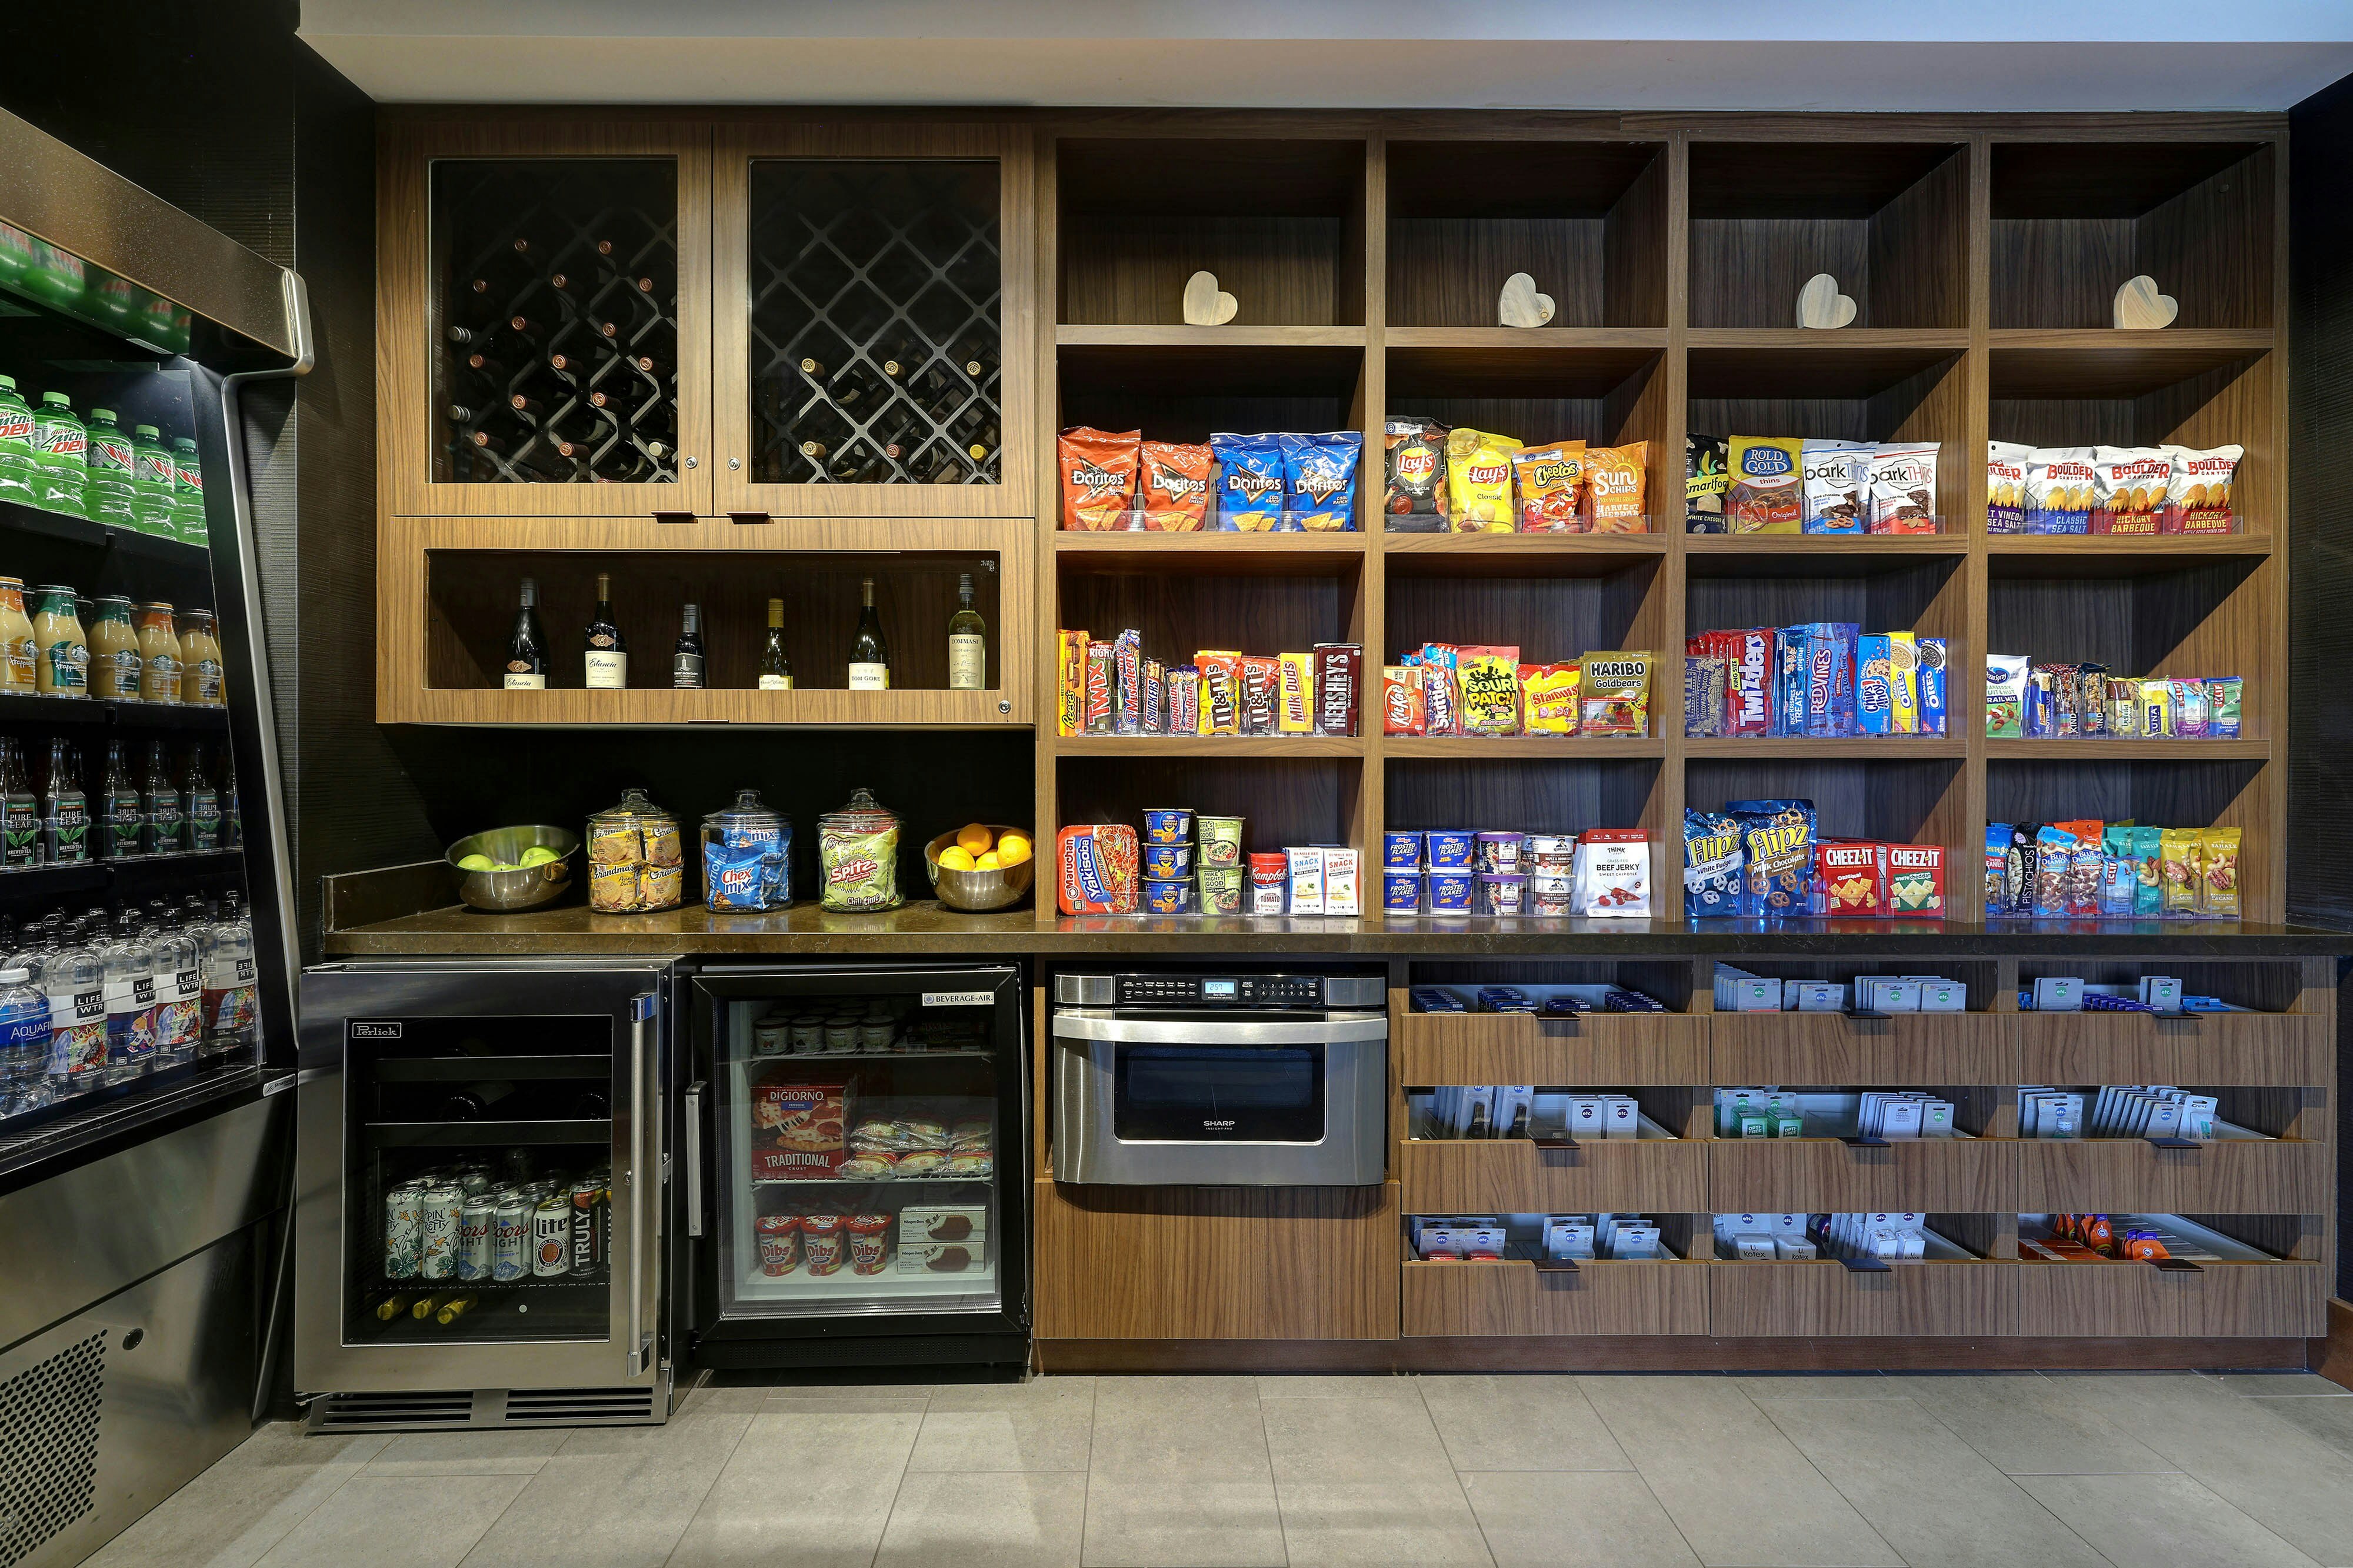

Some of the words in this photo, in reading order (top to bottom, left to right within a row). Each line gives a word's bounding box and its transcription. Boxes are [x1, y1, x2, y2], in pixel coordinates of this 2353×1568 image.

[1750, 449, 1784, 461] ROLD
[1398, 452, 1434, 474] Lay's
[1745, 459, 1787, 472] GOLD
[1072, 470, 1125, 486] Doritos
[1470, 464, 1509, 485] Lay's
[1534, 462, 1578, 487] Cheetos
[2047, 463, 2094, 481] BOULDER
[2112, 461, 2169, 481] BOULDER
[1153, 475, 1206, 492] Doritos
[1228, 475, 1282, 491] Doritos
[1296, 478, 1348, 492] Doritos
[1594, 471, 1638, 496] Sun
[1609, 485, 1638, 495] CHIPS
[1477, 493, 1502, 501] Classic
[1596, 504, 1639, 512] HARVEST
[1771, 510, 1797, 519] Original
[2056, 515, 2087, 525] CLASSIC
[2117, 515, 2151, 523] HICKORY
[2190, 511, 2227, 520] HICKORY
[1988, 519, 2002, 527] SEA
[2051, 523, 2068, 533] SEA
[2069, 524, 2087, 533] SALT
[2111, 523, 2155, 533] BARBEQUE
[2185, 519, 2227, 529] BARBEQUE
[589, 658, 617, 669] Estancia
[1591, 662, 1645, 677] HARIBO
[1860, 658, 1872, 679] ORIGINAL
[506, 677, 531, 687] Estancia
[1124, 651, 1139, 711] Musketeers
[1284, 661, 1299, 693] Duds
[1595, 679, 1642, 689] Goldbears
[1324, 654, 1349, 728] HERSHEY'S
[1467, 679, 1514, 693] SOUR
[1897, 671, 1912, 708] OREO
[1925, 671, 1940, 709] OREO
[1088, 661, 1111, 726] TWIX
[1467, 690, 1516, 708] PATCH
[1864, 685, 1879, 713] Chips
[1146, 679, 1159, 723] SNICKERS
[1062, 689, 1076, 729] Reese's
[1287, 696, 1305, 723] Milk
[1491, 705, 1509, 714] Kids
[1124, 710, 1138, 725] 3
[61, 810, 82, 819] PURE
[752, 830, 777, 842] mix
[825, 838, 838, 851] Big
[1390, 843, 1416, 851] FROSTED
[1438, 842, 1464, 851] FROSTED
[1686, 833, 1741, 869] Flipz
[1747, 824, 1810, 865] Flipz
[1065, 838, 1074, 889] Maruchan
[1294, 858, 1319, 867] SNACK
[1329, 859, 1353, 868] SNACK
[1697, 865, 1715, 875] White
[1715, 859, 1731, 871] Fudge
[1773, 853, 1805, 869] Chocolate
[722, 868, 753, 883] Chex
[829, 859, 878, 886] Spitz
[1078, 837, 1101, 901] Yakisoba
[2108, 862, 2118, 879] CLIF
[2022, 850, 2035, 904] PISTACHIOS
[725, 882, 752, 895] mix
[1390, 884, 1415, 892] FROSTED
[1438, 884, 1465, 892] FROSTED
[847, 896, 863, 906] Chili
[179, 973, 197, 983] LIFE
[136, 981, 154, 991] LIFE
[181, 981, 199, 991] WTR
[77, 994, 101, 1005] LIFE
[80, 1003, 103, 1013] WTR
[356, 1025, 397, 1036] Perlick
[764, 1153, 831, 1169] TRADITIONAL
[535, 1217, 568, 1239] Lite
[575, 1209, 591, 1267] TRULY
[762, 1244, 791, 1257] Dibs
[806, 1244, 835, 1257] Dibs
[852, 1243, 881, 1257] Dibs
[1744, 1250, 1765, 1258] kotex
